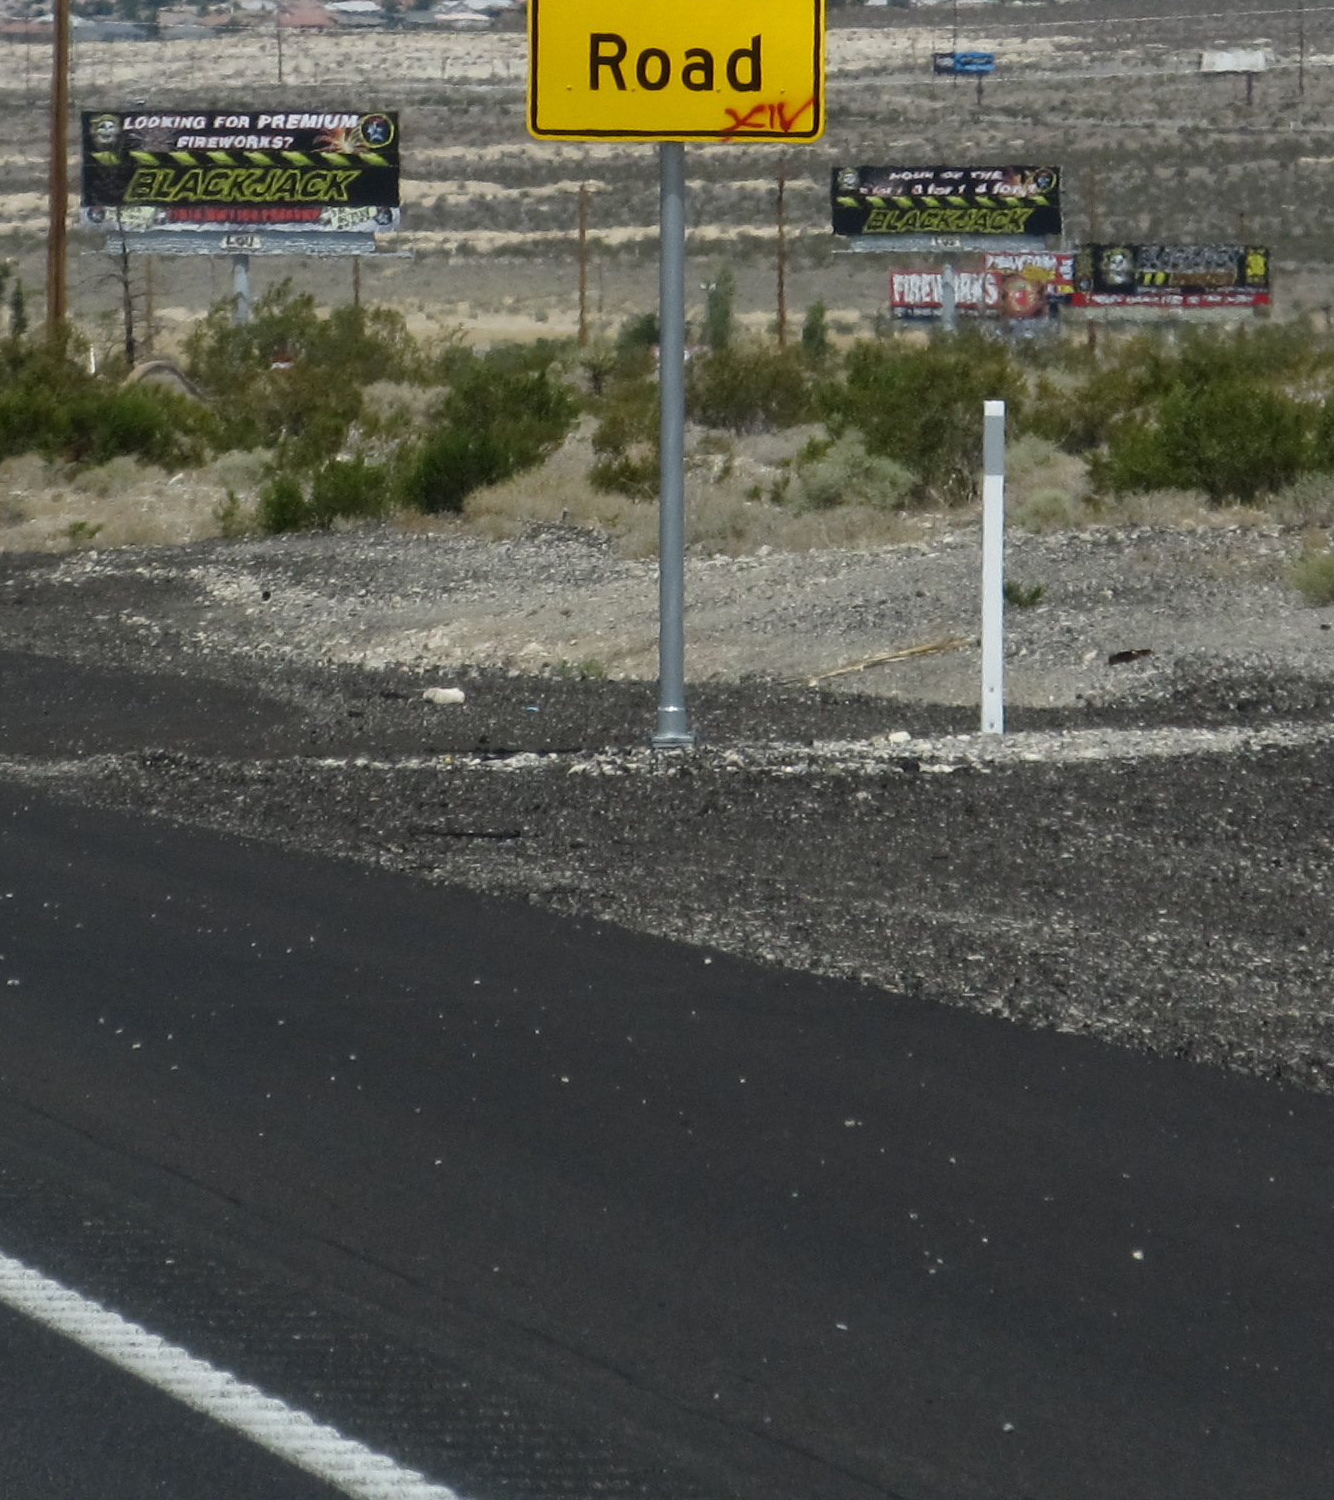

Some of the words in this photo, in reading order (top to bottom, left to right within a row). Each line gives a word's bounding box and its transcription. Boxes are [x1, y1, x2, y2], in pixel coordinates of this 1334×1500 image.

[589, 33, 762, 92] Road
[123, 114, 207, 130] LOOKING
[212, 115, 250, 130] FOR
[256, 113, 358, 129] PREMIUM
[176, 135, 295, 150] FIREWORKS?
[123, 167, 363, 202] BLACKJACK
[862, 208, 1036, 234] BLACKJACK
